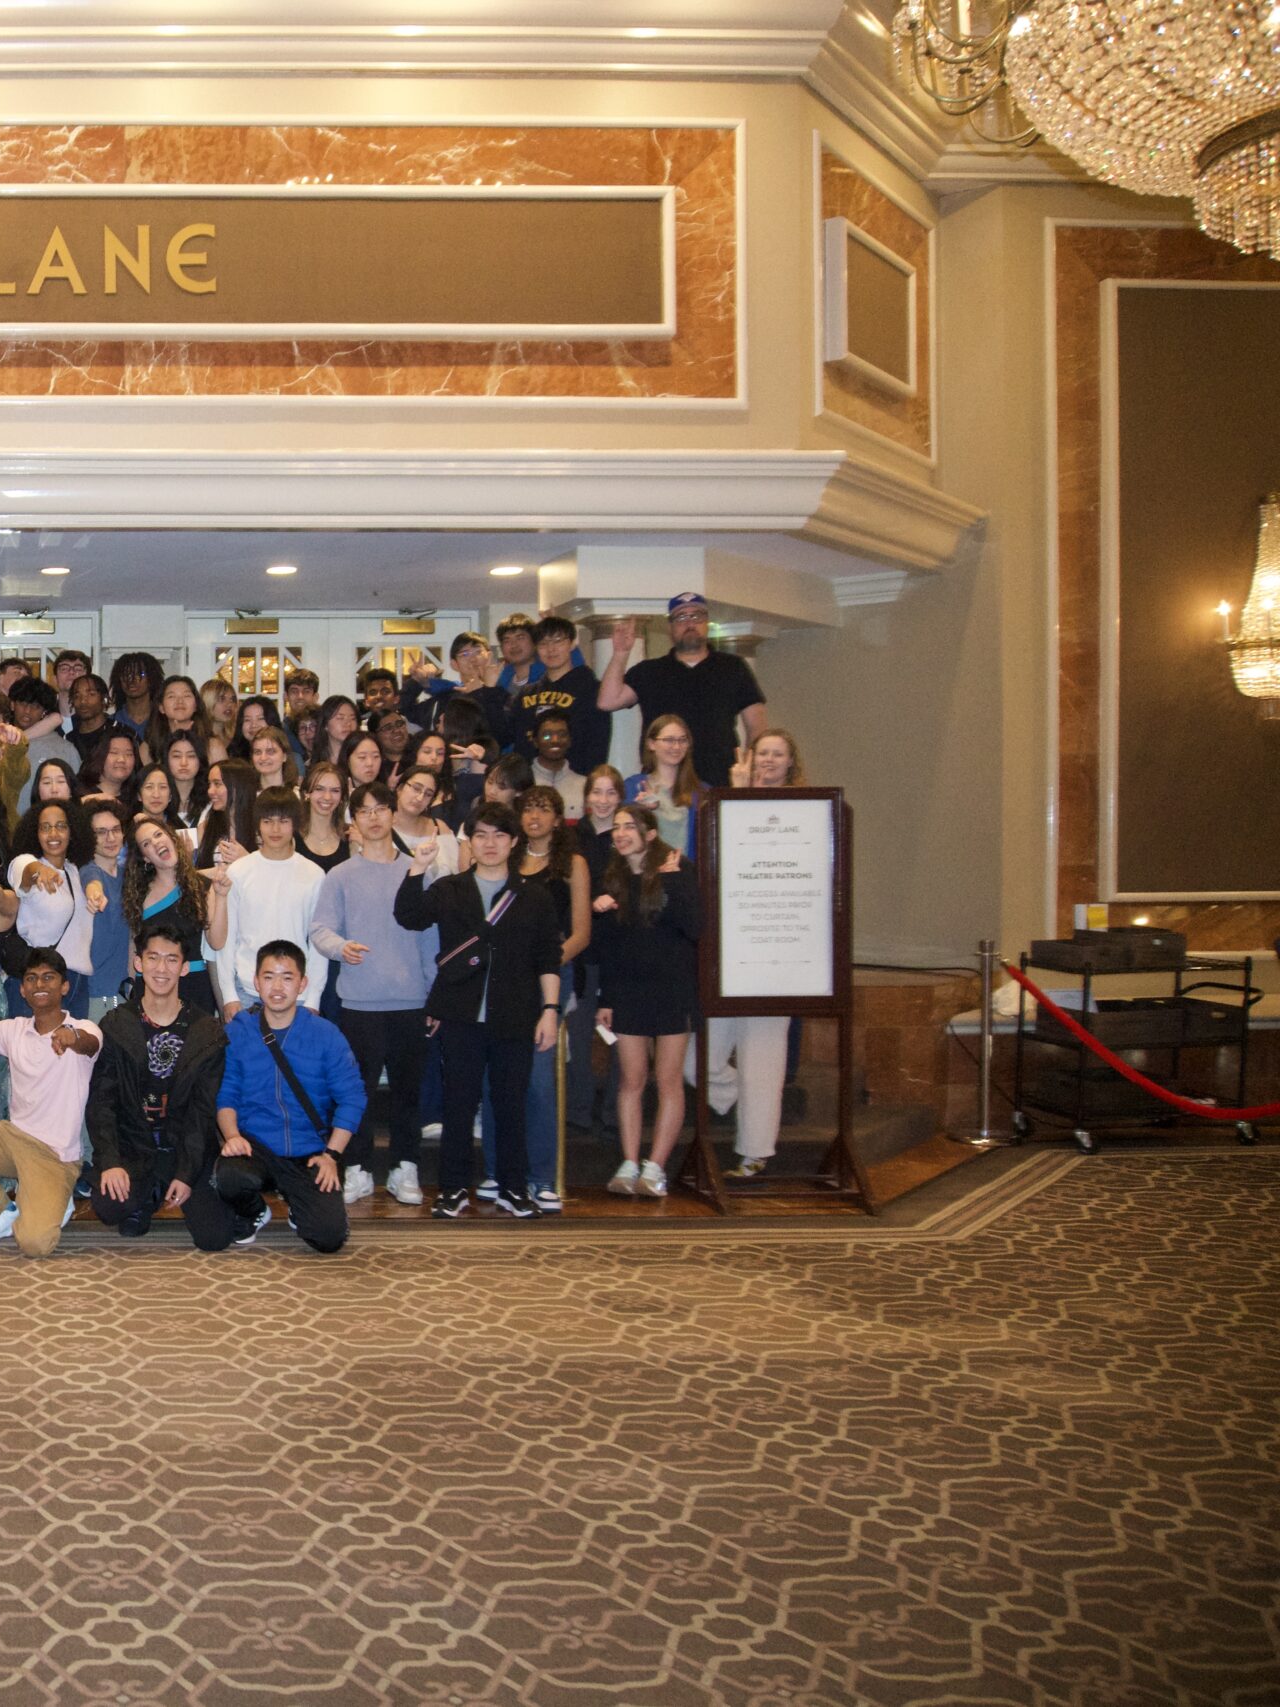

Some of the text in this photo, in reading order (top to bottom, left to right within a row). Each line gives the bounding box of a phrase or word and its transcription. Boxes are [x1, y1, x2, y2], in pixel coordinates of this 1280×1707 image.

[523, 691, 573, 708] NYPD
[748, 825, 800, 834] DRURY LANE
